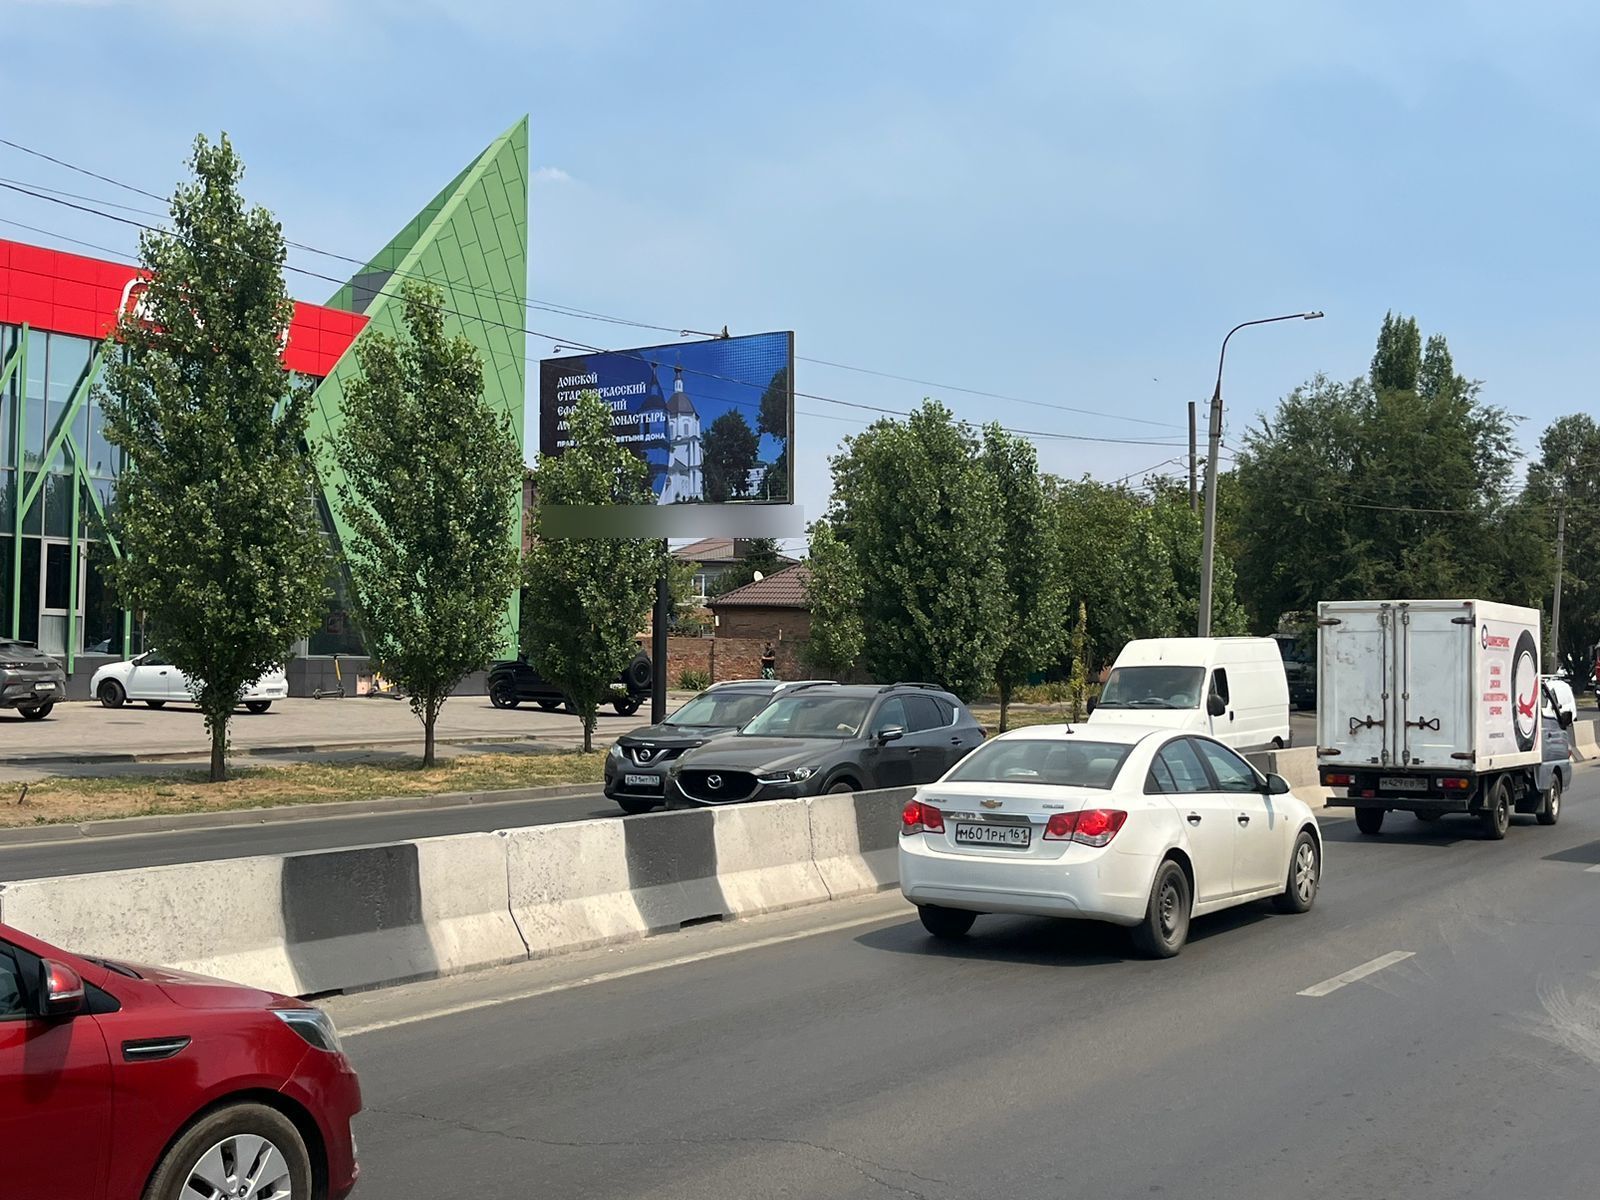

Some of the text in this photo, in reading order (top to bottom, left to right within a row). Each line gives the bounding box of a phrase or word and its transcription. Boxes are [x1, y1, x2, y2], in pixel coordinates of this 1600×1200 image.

[557, 372, 598, 388] ДОНСКОЙ
[645, 432, 666, 441] ДОНА
[960, 827, 1027, 842] М601РН 161
